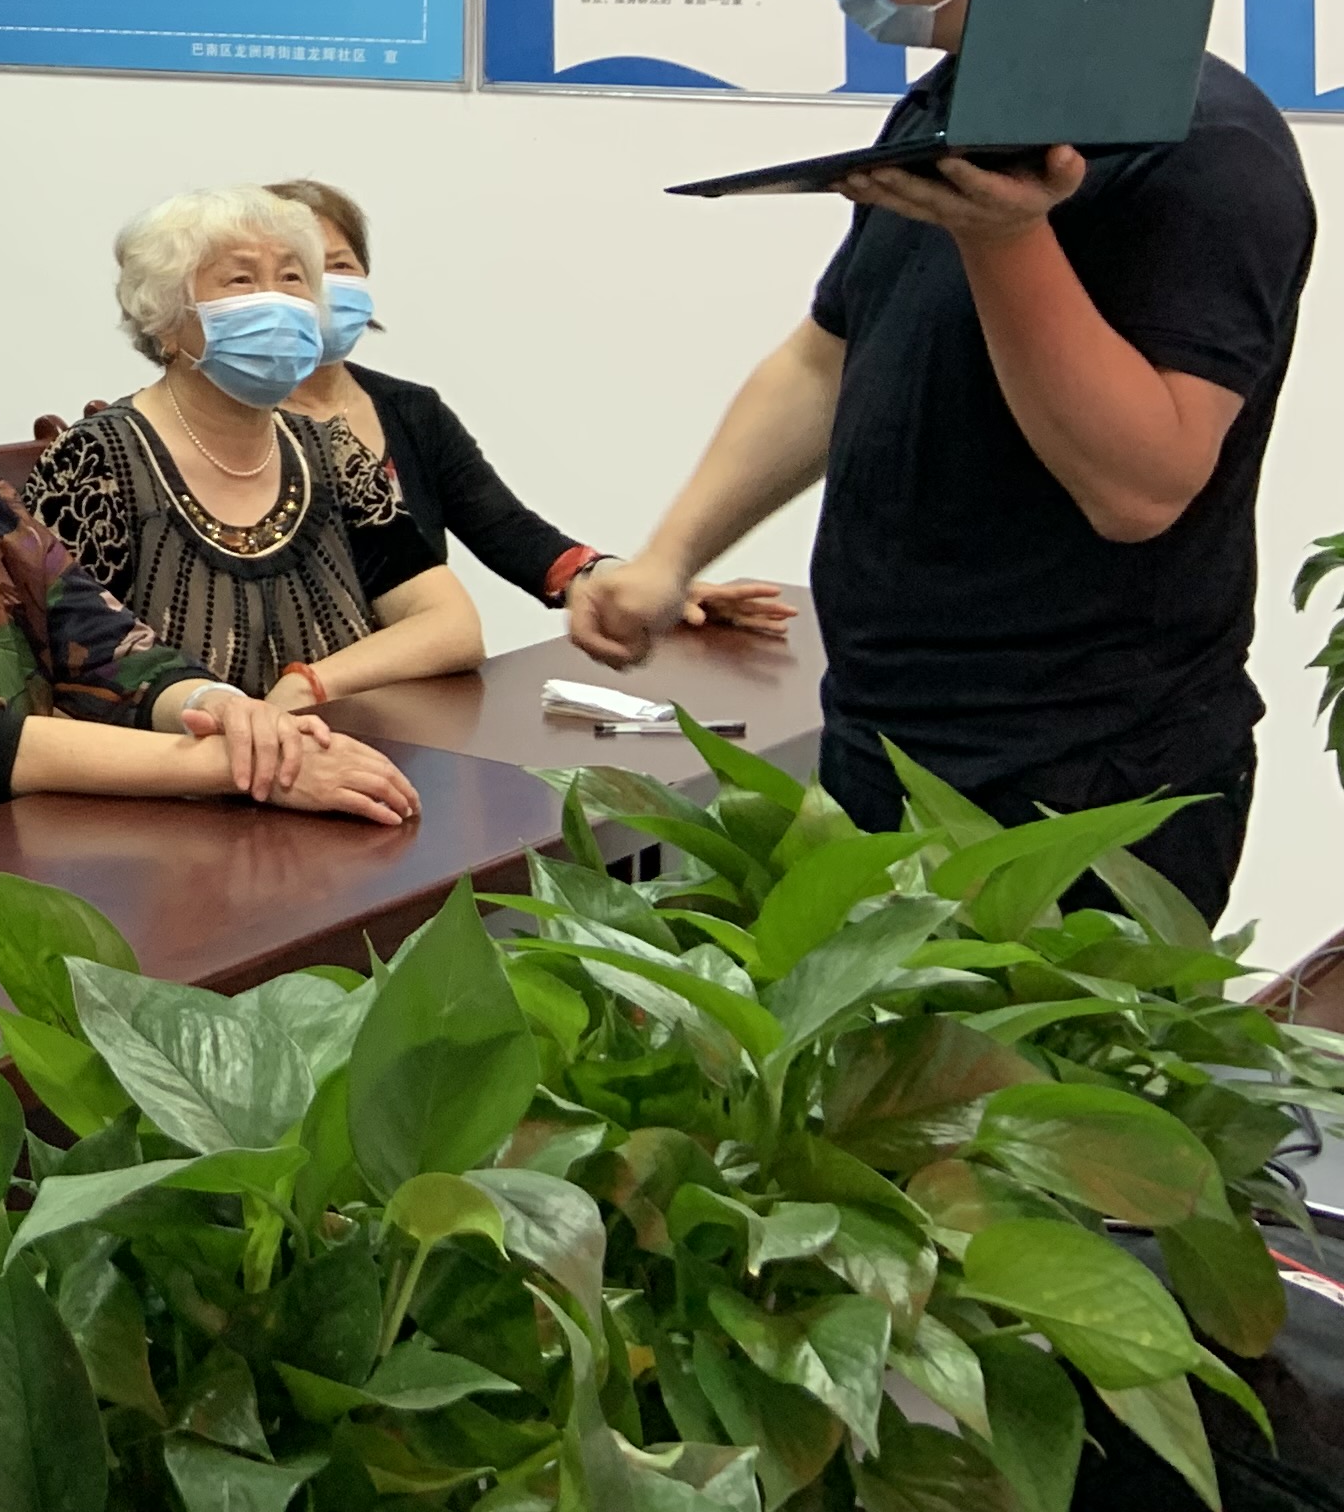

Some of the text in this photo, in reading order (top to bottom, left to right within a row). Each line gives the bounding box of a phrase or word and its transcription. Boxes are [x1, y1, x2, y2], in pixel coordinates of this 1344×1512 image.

[191, 42, 367, 63] 巴南区龙洲湾街道龙辉社区
